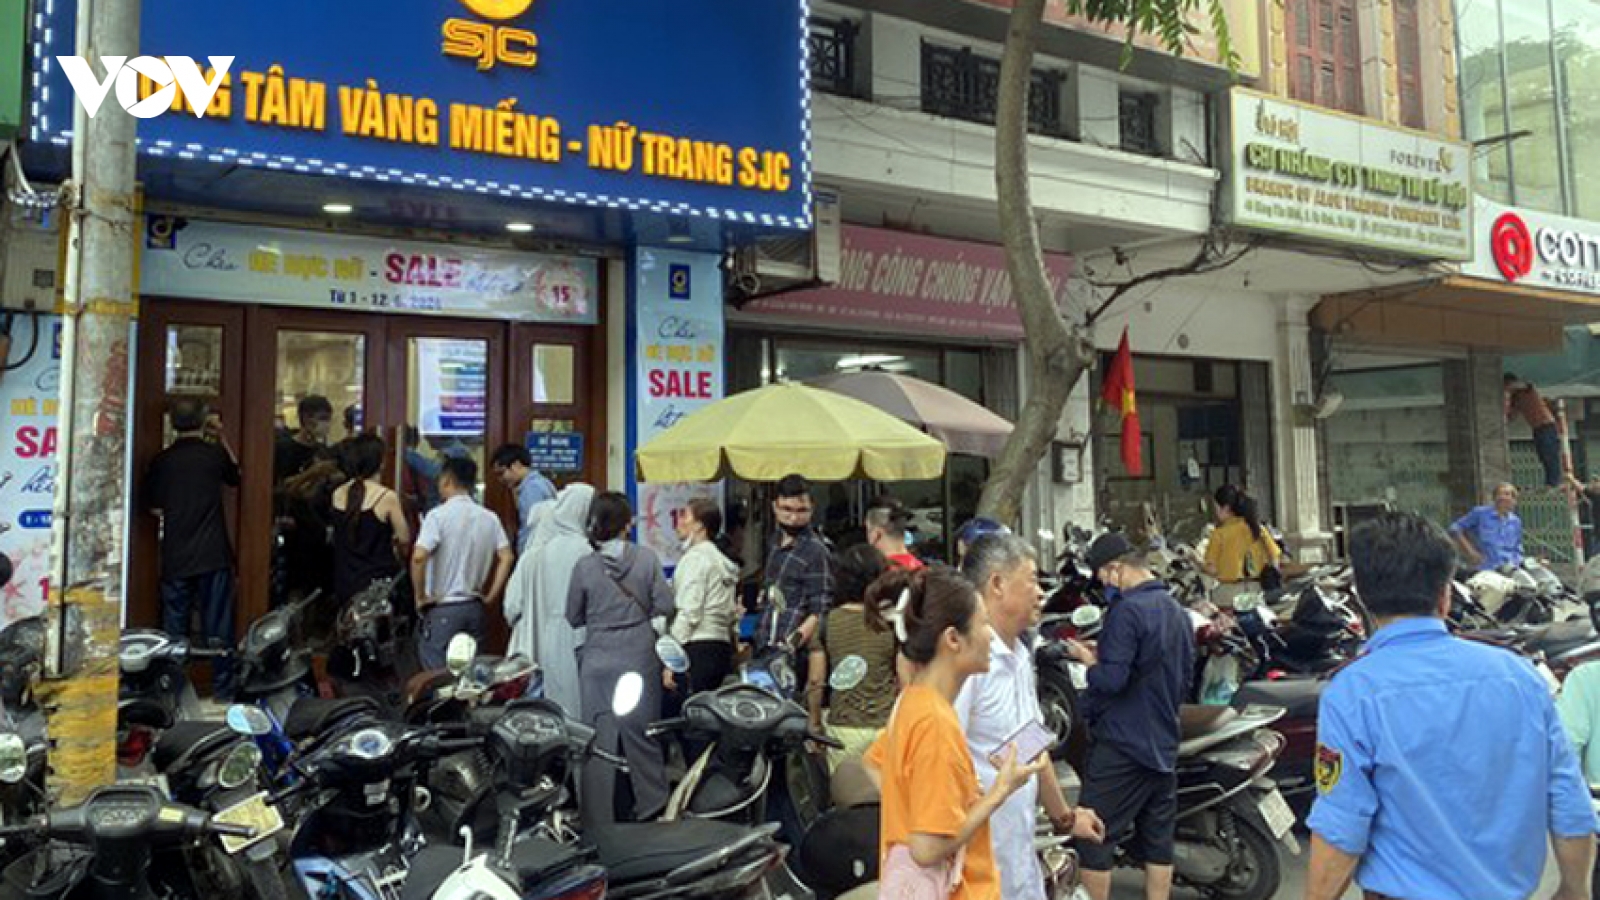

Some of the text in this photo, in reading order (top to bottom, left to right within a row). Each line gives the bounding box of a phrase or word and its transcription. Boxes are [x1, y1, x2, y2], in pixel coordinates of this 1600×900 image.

[240, 63, 326, 131] TÂM
[338, 78, 439, 145] VÀNG
[450, 97, 561, 162] MIẾNG
[568, 141, 582, 152] -
[588, 121, 637, 171] NỮ
[639, 131, 733, 185] TRANG
[738, 147, 790, 191] SJC
[385, 253, 463, 288] SALE
[648, 368, 712, 399] SALE
